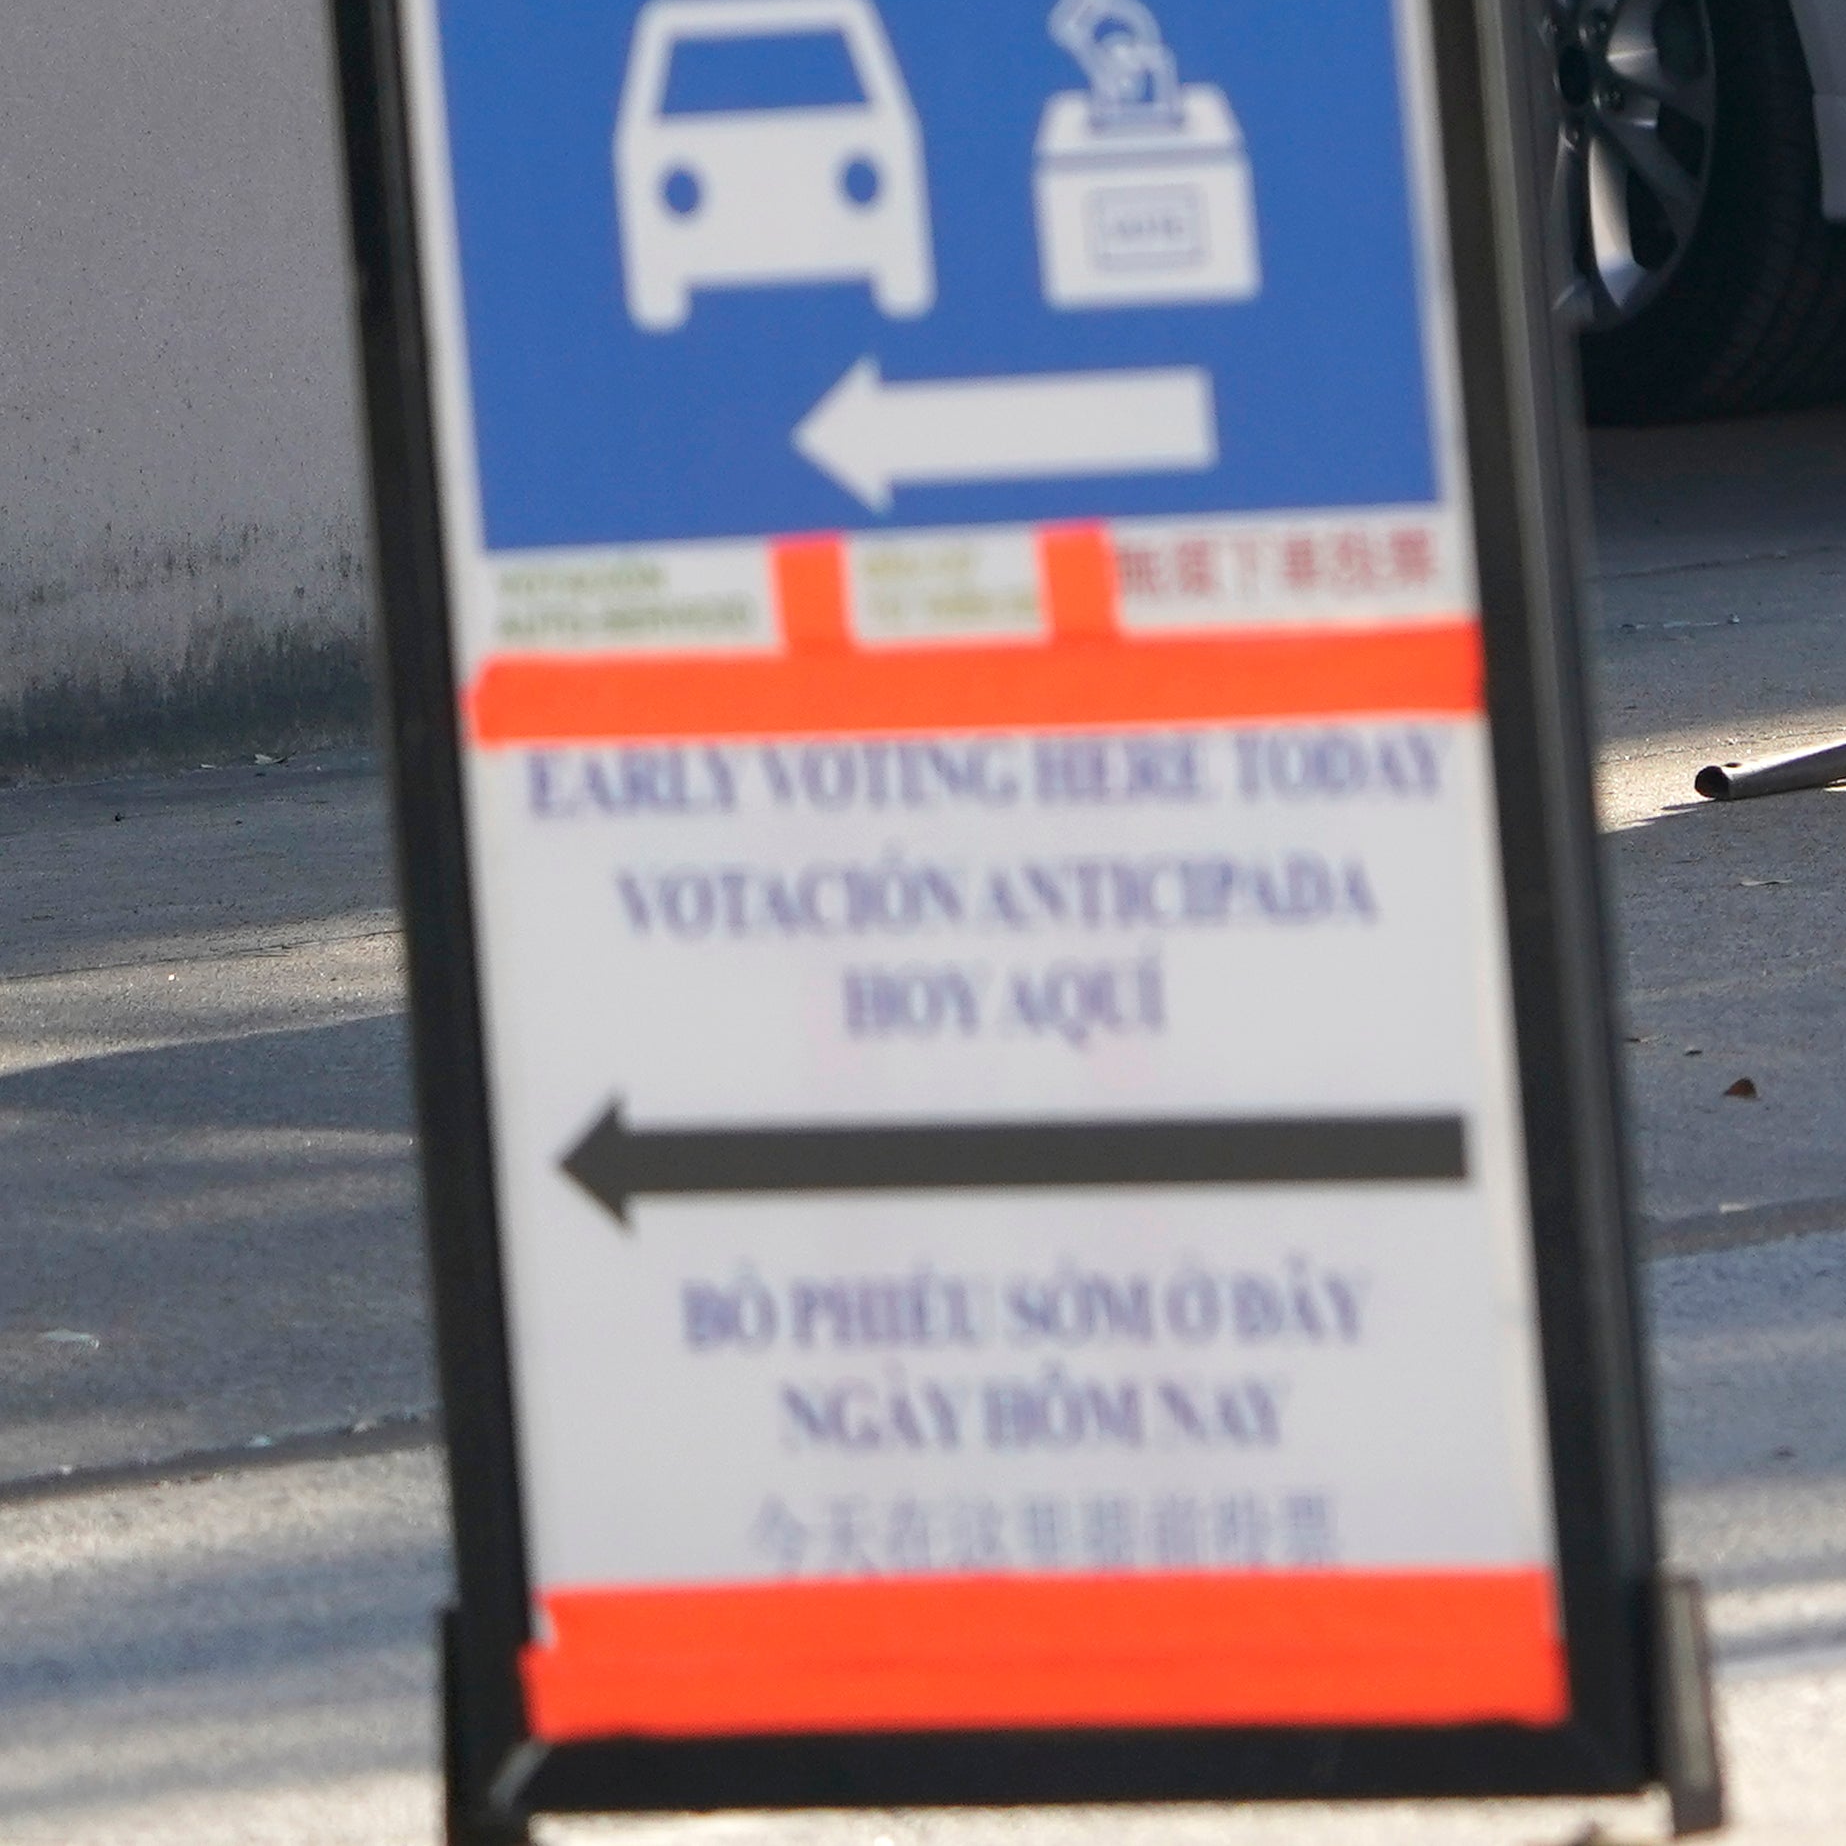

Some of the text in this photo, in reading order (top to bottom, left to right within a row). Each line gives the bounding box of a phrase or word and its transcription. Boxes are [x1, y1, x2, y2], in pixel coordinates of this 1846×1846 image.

[527, 722, 1445, 819] EARLY VOTING HERE TODAY
[617, 838, 1380, 938] VOTACIÓN ANTICIPADA
[844, 946, 1169, 1052] HOY AQUÍ
